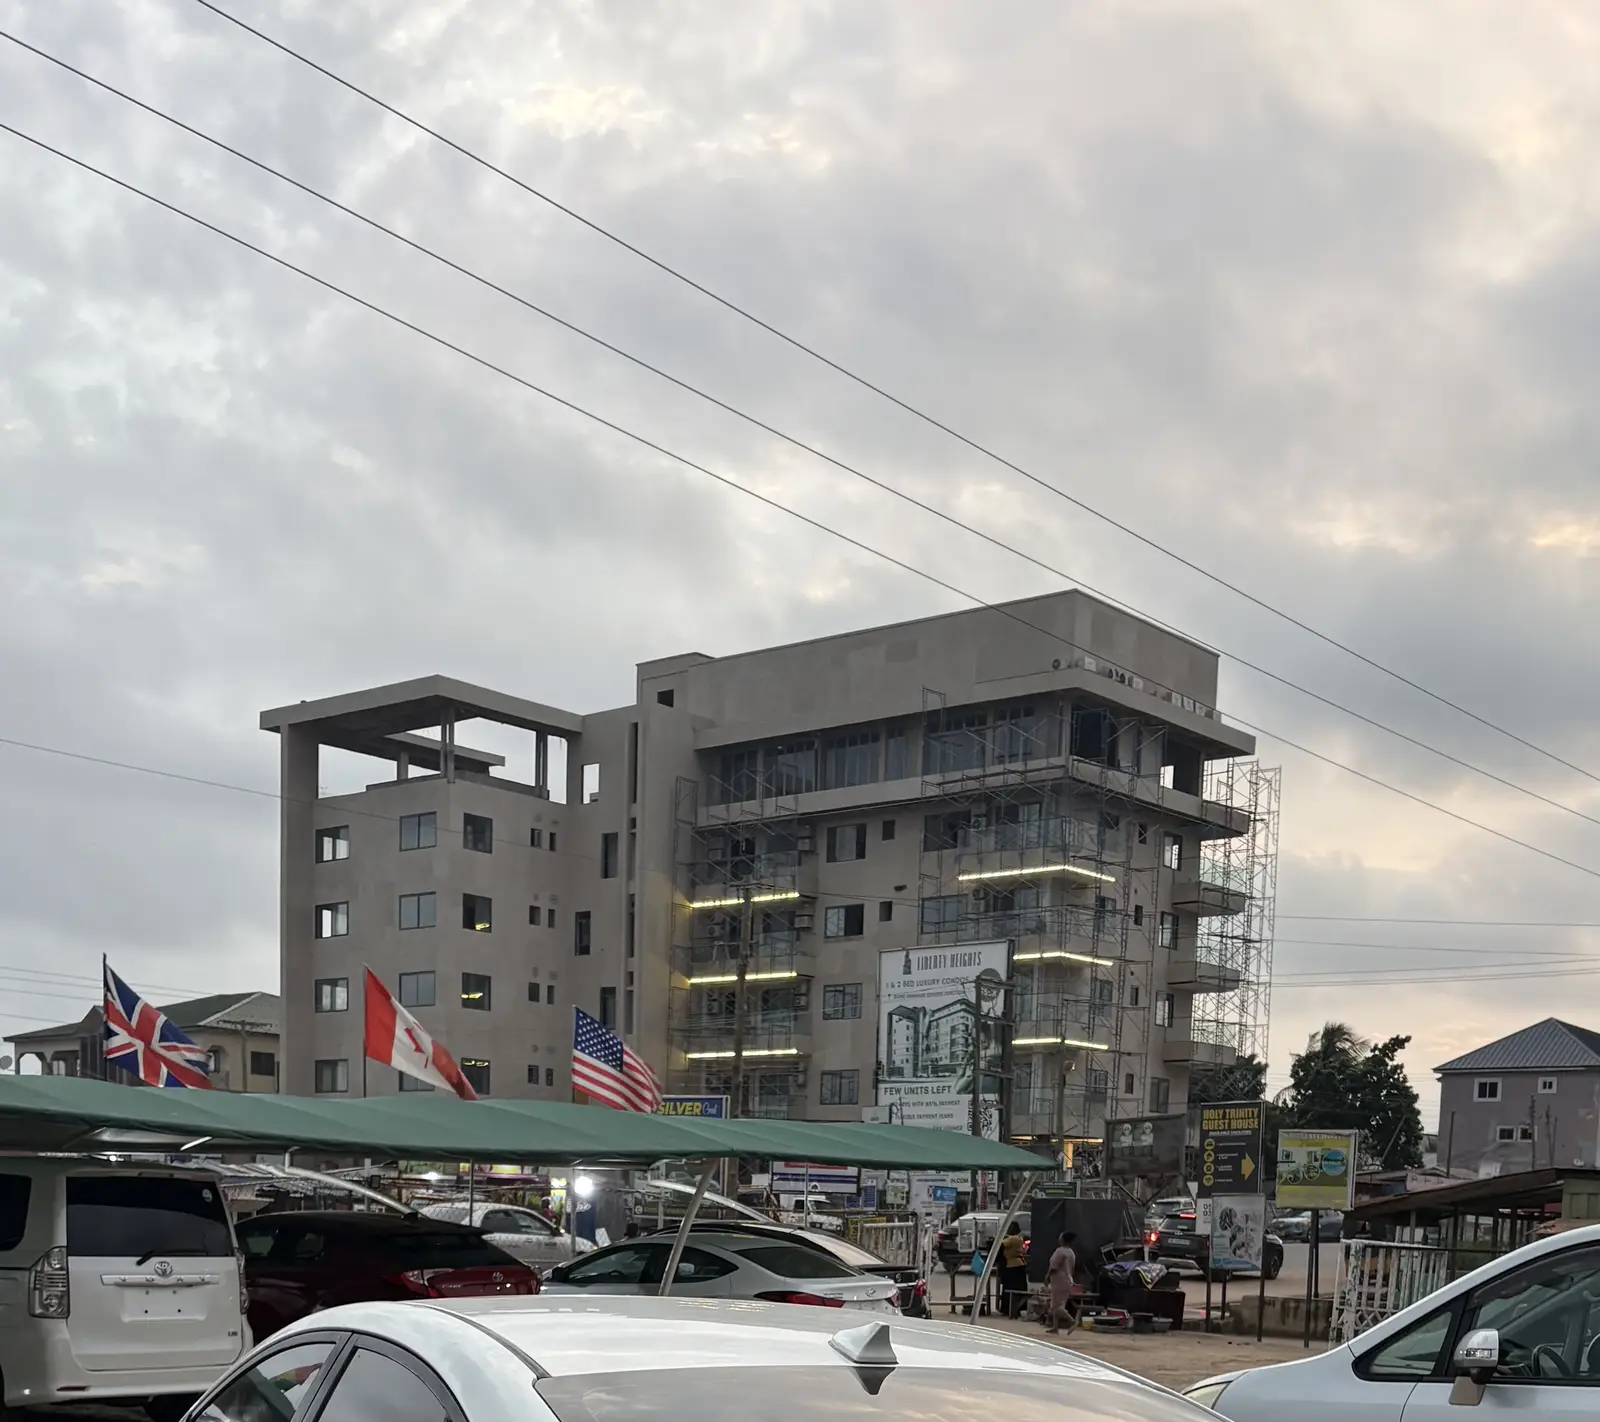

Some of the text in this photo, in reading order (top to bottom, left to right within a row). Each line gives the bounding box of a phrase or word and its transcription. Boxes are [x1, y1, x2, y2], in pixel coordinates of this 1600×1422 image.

[917, 951, 982, 971] LIBERTY HEIGHTS
[903, 980, 915, 988] BED
[916, 978, 940, 987] LUXURY
[884, 1085, 952, 1096] FEW UNITS LEFT
[658, 1101, 702, 1115] SILVER
[1203, 1108, 1259, 1119] HOLY TRINITY
[1202, 1118, 1259, 1130] GUEST HOUSE
